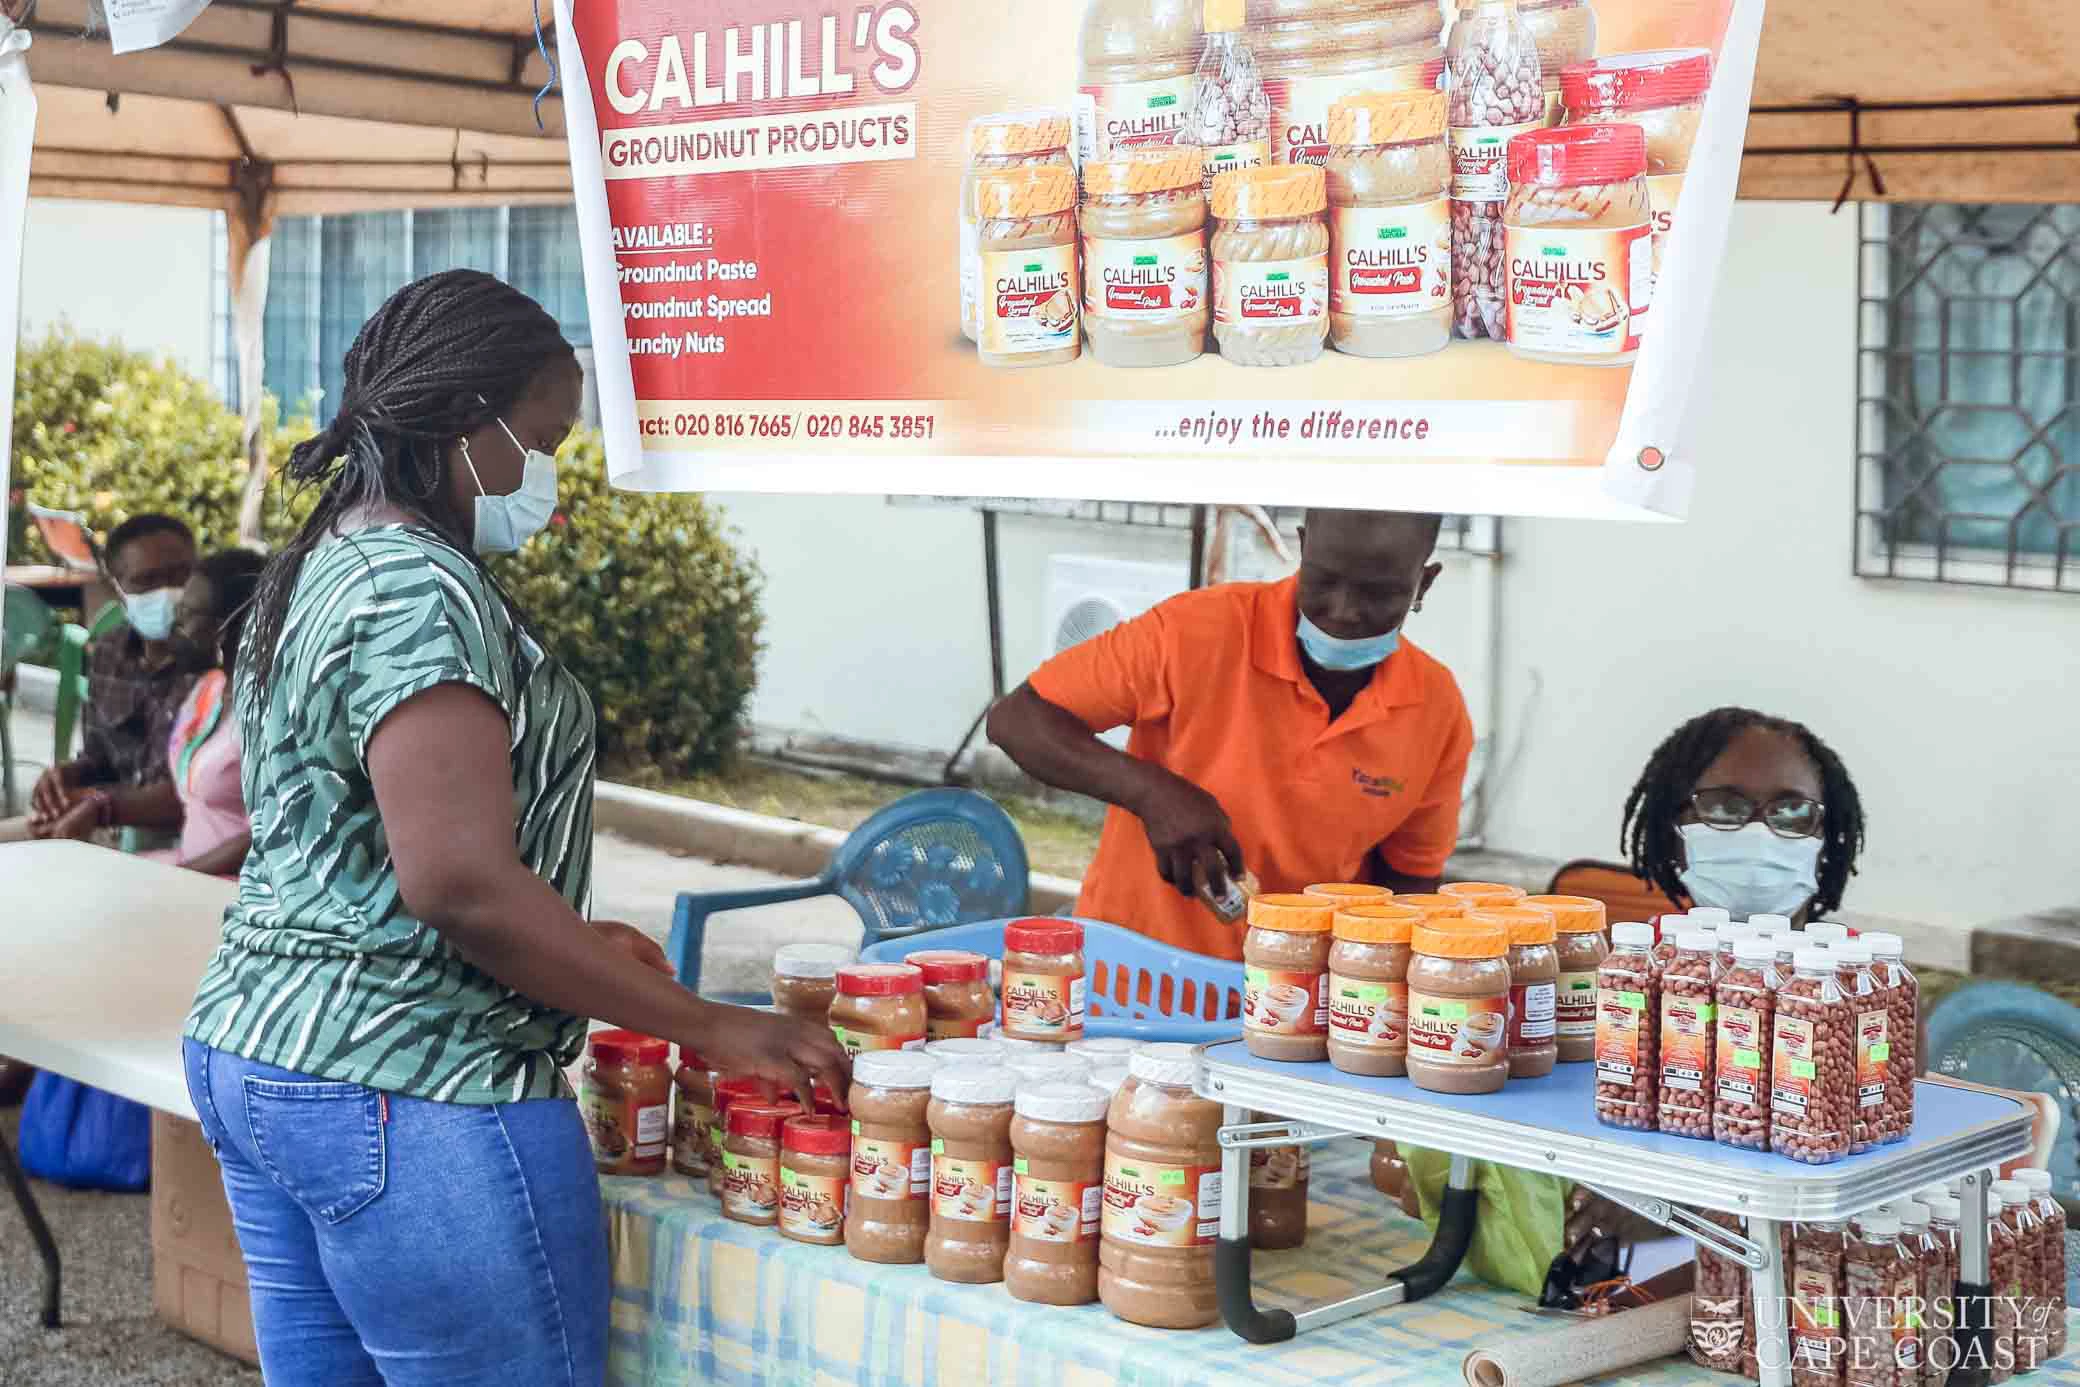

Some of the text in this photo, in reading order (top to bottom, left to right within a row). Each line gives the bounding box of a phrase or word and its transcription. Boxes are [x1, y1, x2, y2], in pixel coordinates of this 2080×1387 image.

[605, 7, 918, 115] CALHILL'S
[608, 114, 909, 166] GROUNDNUT PRODUCTS
[1347, 245, 1427, 267] CALHILL'S
[707, 259, 758, 281] Paste
[1103, 265, 1176, 285] CALHILL'S
[1512, 258, 1606, 280] CALHILL'S
[996, 271, 1068, 293] CALHILL'S
[1240, 281, 1305, 297] CALHILL'S
[624, 293, 771, 322] roundnut Spread
[628, 332, 725, 359] unchy Nuts
[674, 414, 709, 436] 020
[715, 414, 744, 437] 816
[807, 414, 843, 437] 020
[849, 415, 884, 438] 845
[890, 415, 934, 439] 3851
[1252, 411, 1290, 439] the
[1300, 409, 1429, 440] difference
